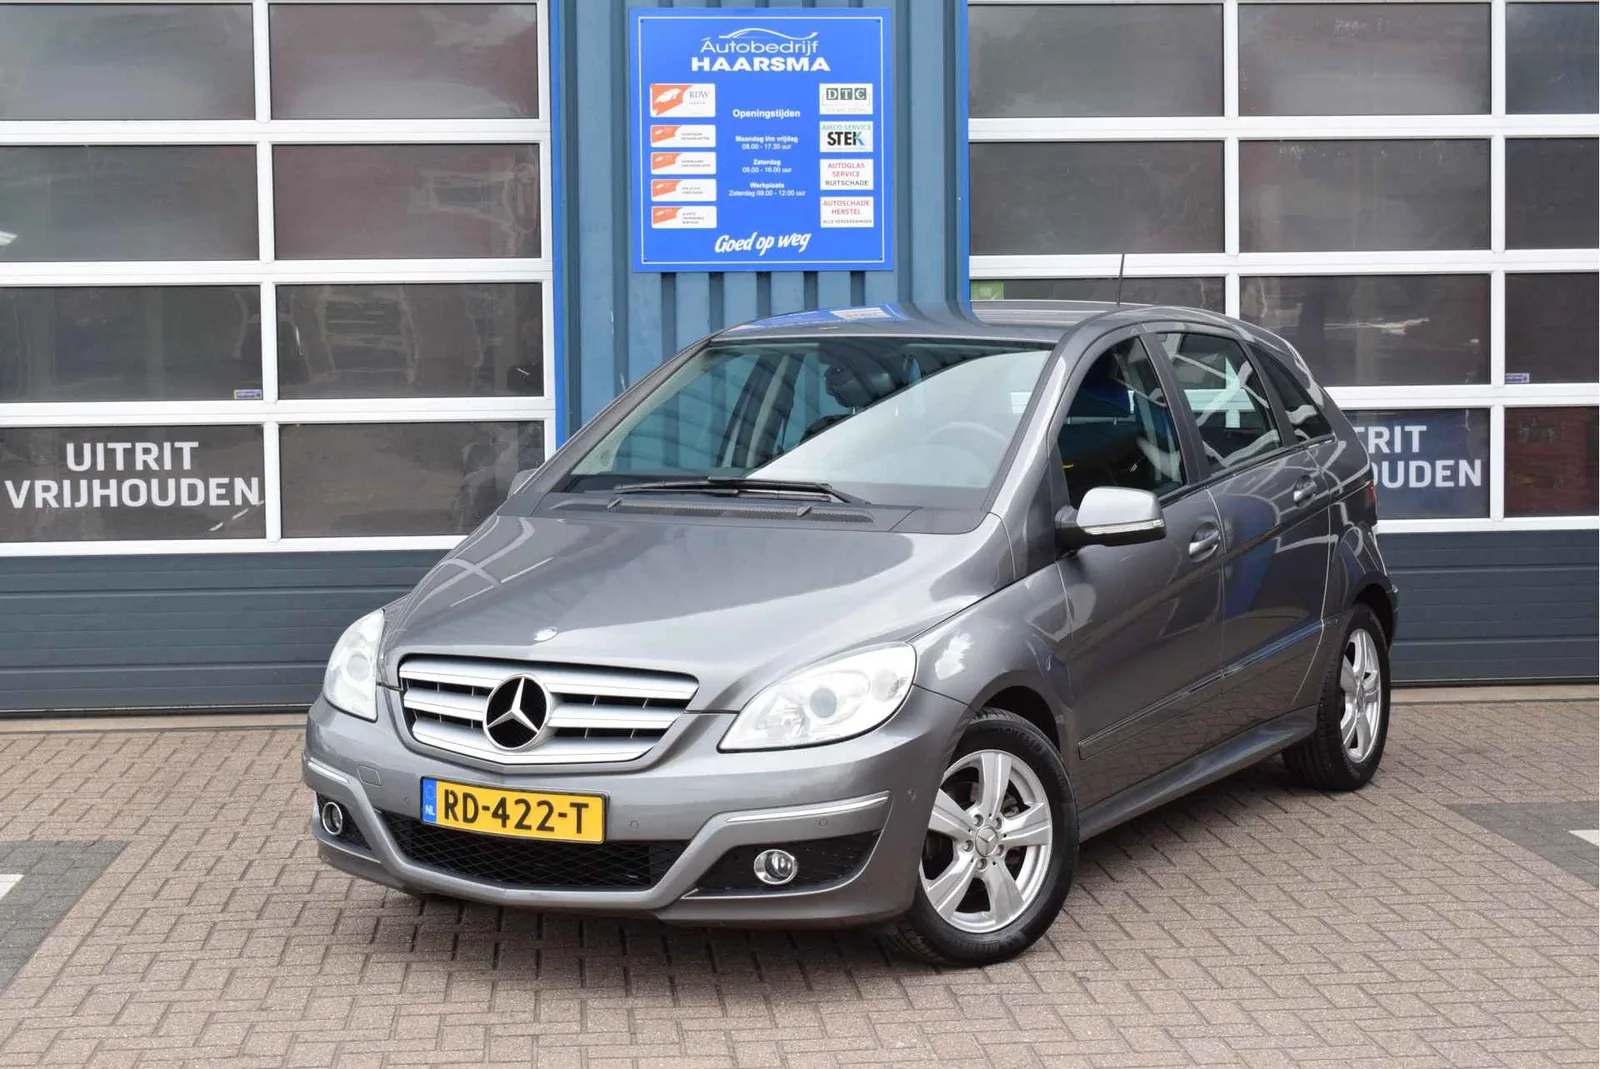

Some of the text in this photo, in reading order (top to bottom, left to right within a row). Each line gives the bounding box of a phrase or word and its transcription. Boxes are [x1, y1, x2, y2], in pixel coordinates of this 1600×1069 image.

[700, 40, 819, 56] Autobedrijf
[691, 57, 831, 72] HAARSMA
[826, 87, 867, 101] DTC
[732, 109, 801, 120] Openingstijden
[735, 135, 764, 143] Maandag
[776, 135, 799, 143] vrijdag
[827, 131, 865, 146] STEK
[753, 158, 782, 166] Zaterdag
[749, 181, 785, 189] Werkplaats
[714, 231, 812, 257] Goed op weg
[66, 441, 200, 471] UITRIT
[1372, 459, 1482, 488] UDEN
[4, 477, 260, 509] VRIJHOUDEN
[425, 804, 436, 817] NL
[443, 788, 590, 835] RD-422-T
